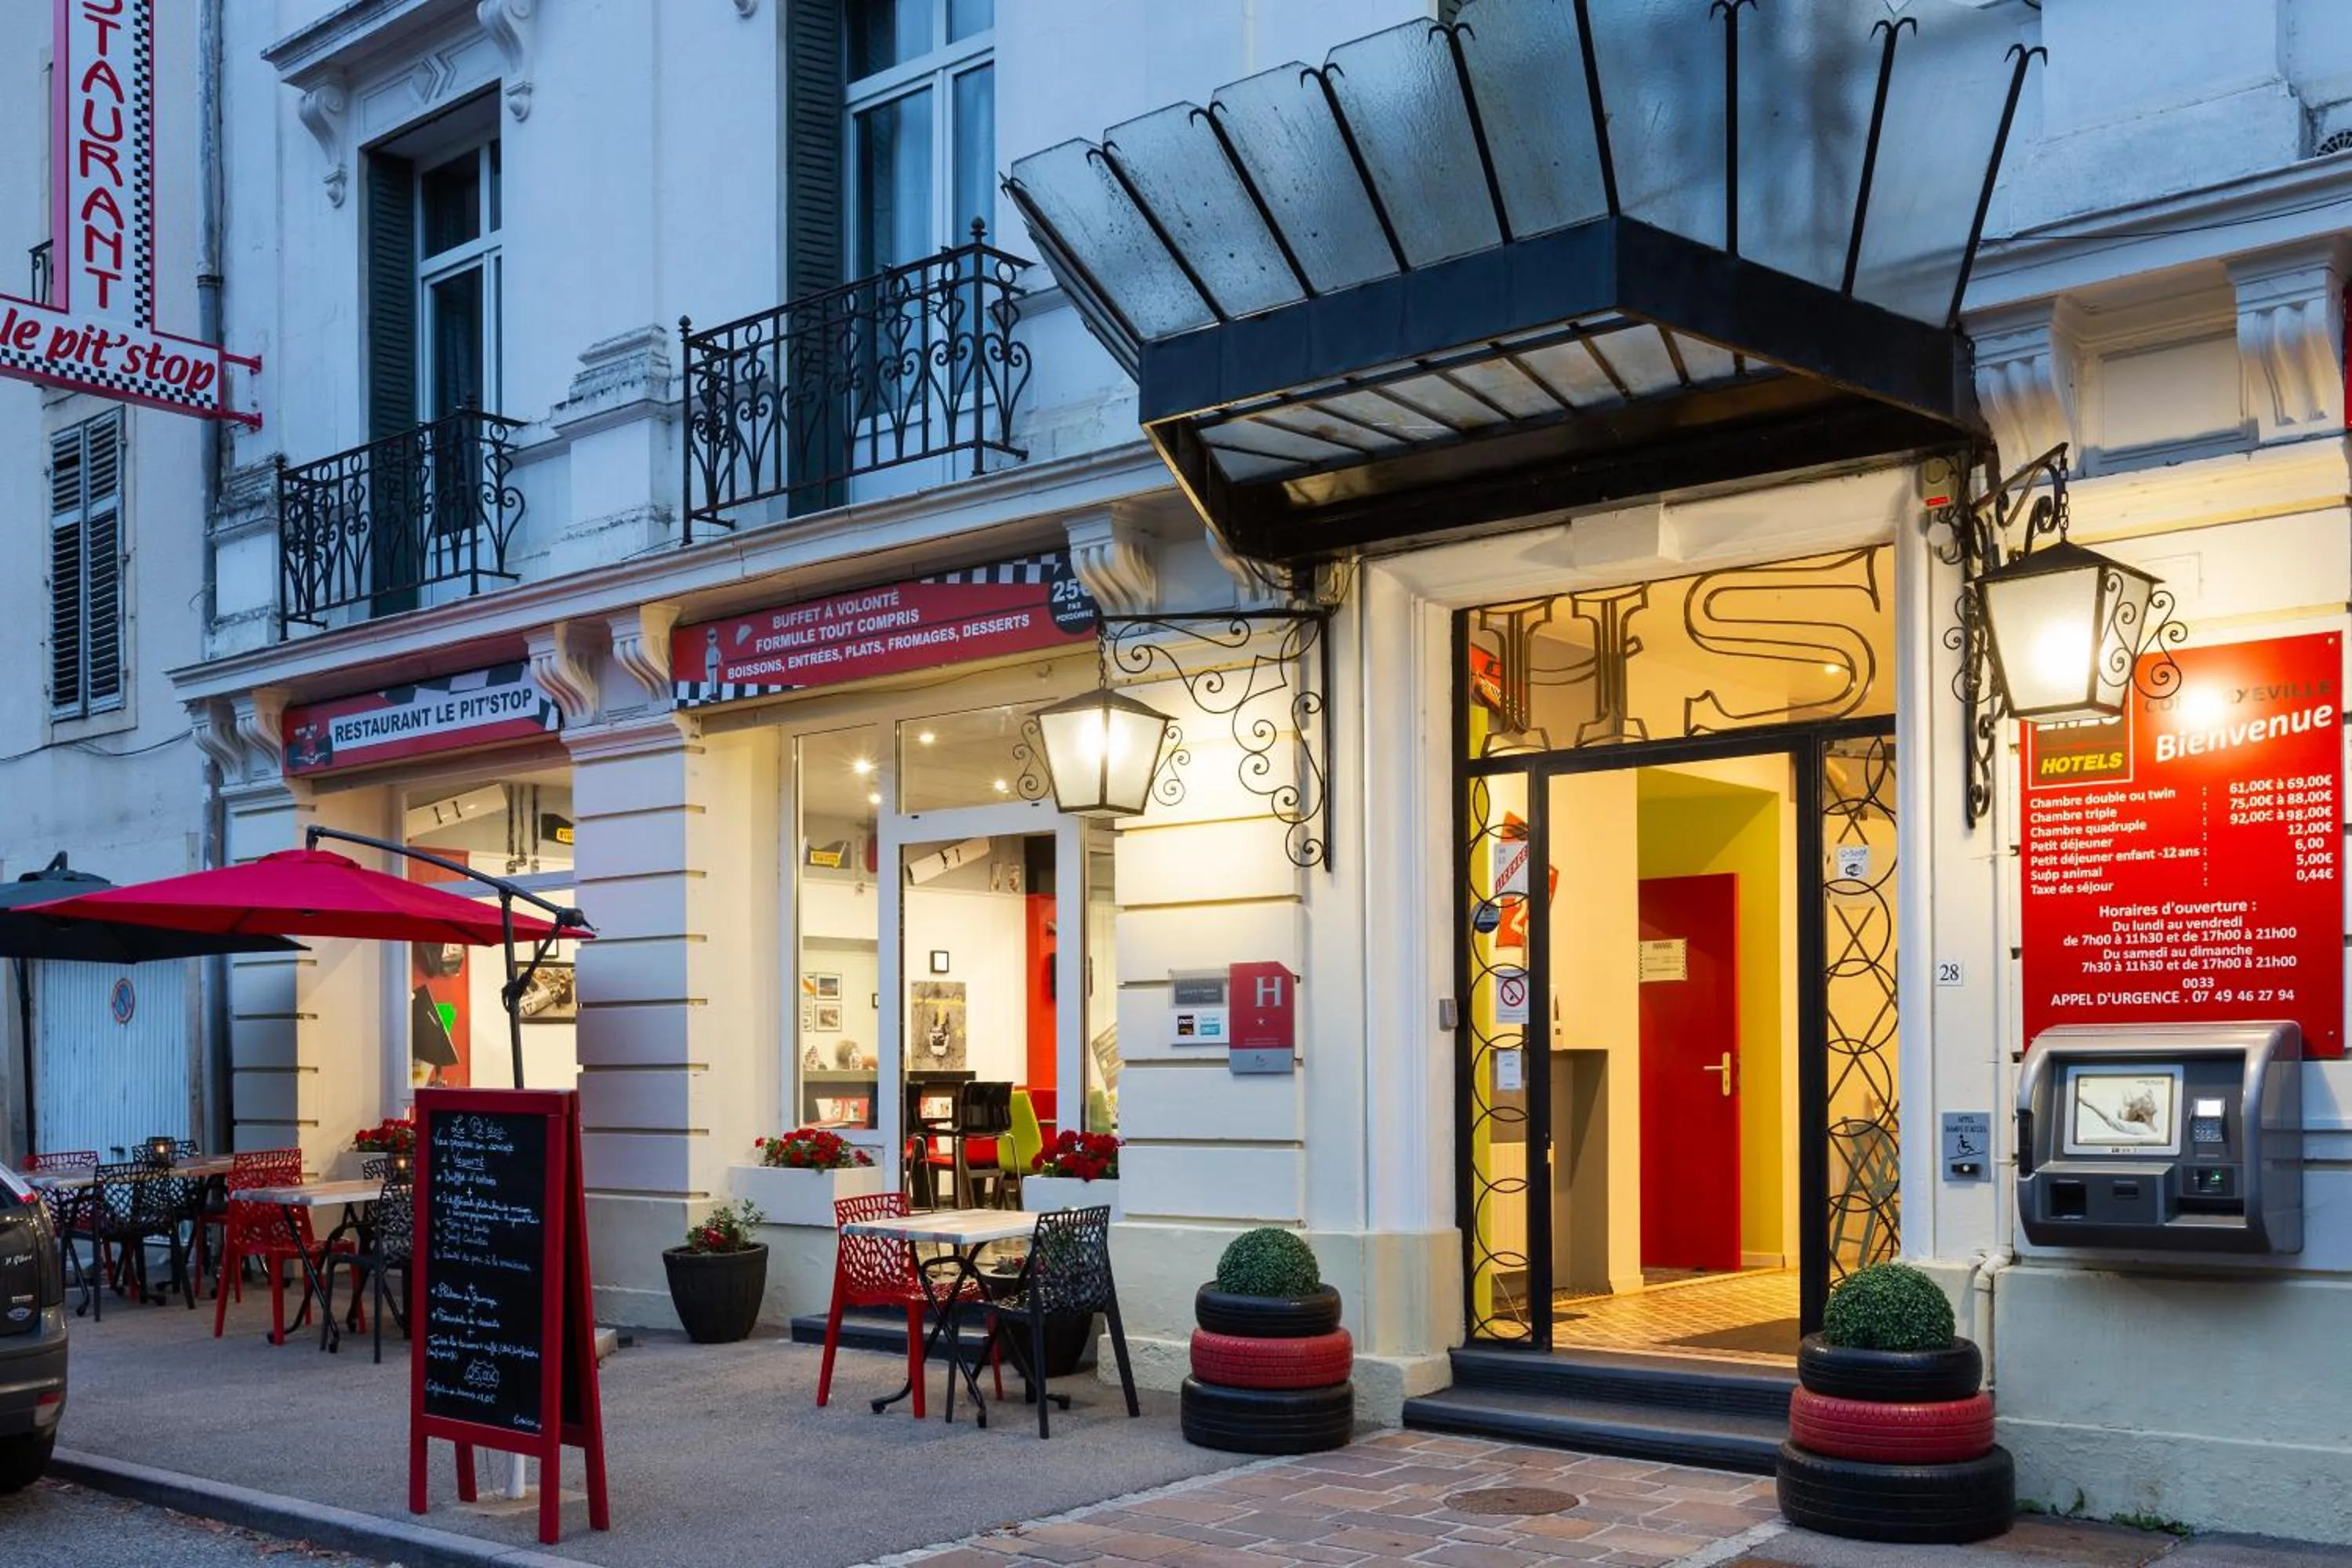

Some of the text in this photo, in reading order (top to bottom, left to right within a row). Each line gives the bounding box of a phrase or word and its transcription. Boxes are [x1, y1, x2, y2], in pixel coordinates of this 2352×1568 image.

[0, 308, 216, 392] le pit'stop
[772, 590, 900, 630] BUFFET À VOLONTÉ
[756, 608, 920, 653] FORMULE TOUT COMPRIS
[727, 614, 1030, 681] BOISSONS, ENTRÉES, PLATS, FROMAGES, DESSERTS
[334, 688, 533, 743] RESTAURANT LE PIT'STOP
[2155, 704, 2333, 763] Bienvenue
[2041, 752, 2124, 775] HOTELS
[2030, 796, 2082, 809] Chambre
[2085, 792, 2126, 804] double
[2147, 787, 2176, 799] twin
[2030, 811, 2082, 823] Chambre
[2085, 807, 2118, 821] triple
[2030, 826, 2082, 838] Chambre
[2085, 820, 2147, 835] quadruple
[2031, 841, 2058, 852] Petit
[2060, 837, 2113, 851] déjeuner
[2287, 821, 2333, 836] 12,00€
[2031, 855, 2058, 867] Petit
[2060, 852, 2113, 866] déjeuner
[2116, 848, 2155, 862] enfant
[2178, 847, 2201, 858] ans
[2062, 866, 2103, 879] animal
[2031, 884, 2056, 895] Taxe
[2059, 882, 2074, 894] de
[2076, 880, 2114, 895] séjour
[2099, 904, 2158, 918] Horaires
[2161, 901, 2248, 916] d'ouverture
[2112, 915, 2243, 932] Du lundi au vendredi
[2063, 927, 2297, 947] de 7h00 à 11h30 et de 17h00 à 21h00
[2103, 944, 2253, 960] Du samedi au dimanche
[1939, 963, 1959, 981] 28
[2082, 955, 2297, 973] 7h30 à 11h30 et de 17h00 à 21h00
[1255, 976, 1283, 1007] H
[2182, 976, 2215, 989] 0033
[2050, 993, 2093, 1007] APPEL
[2096, 991, 2180, 1005] D'URGENCE
[2191, 991, 2209, 1003] 07
[2214, 990, 2232, 1002] 49
[2237, 989, 2255, 1002] 46
[2257, 989, 2274, 1001] 27
[2277, 989, 2296, 1001] 94
